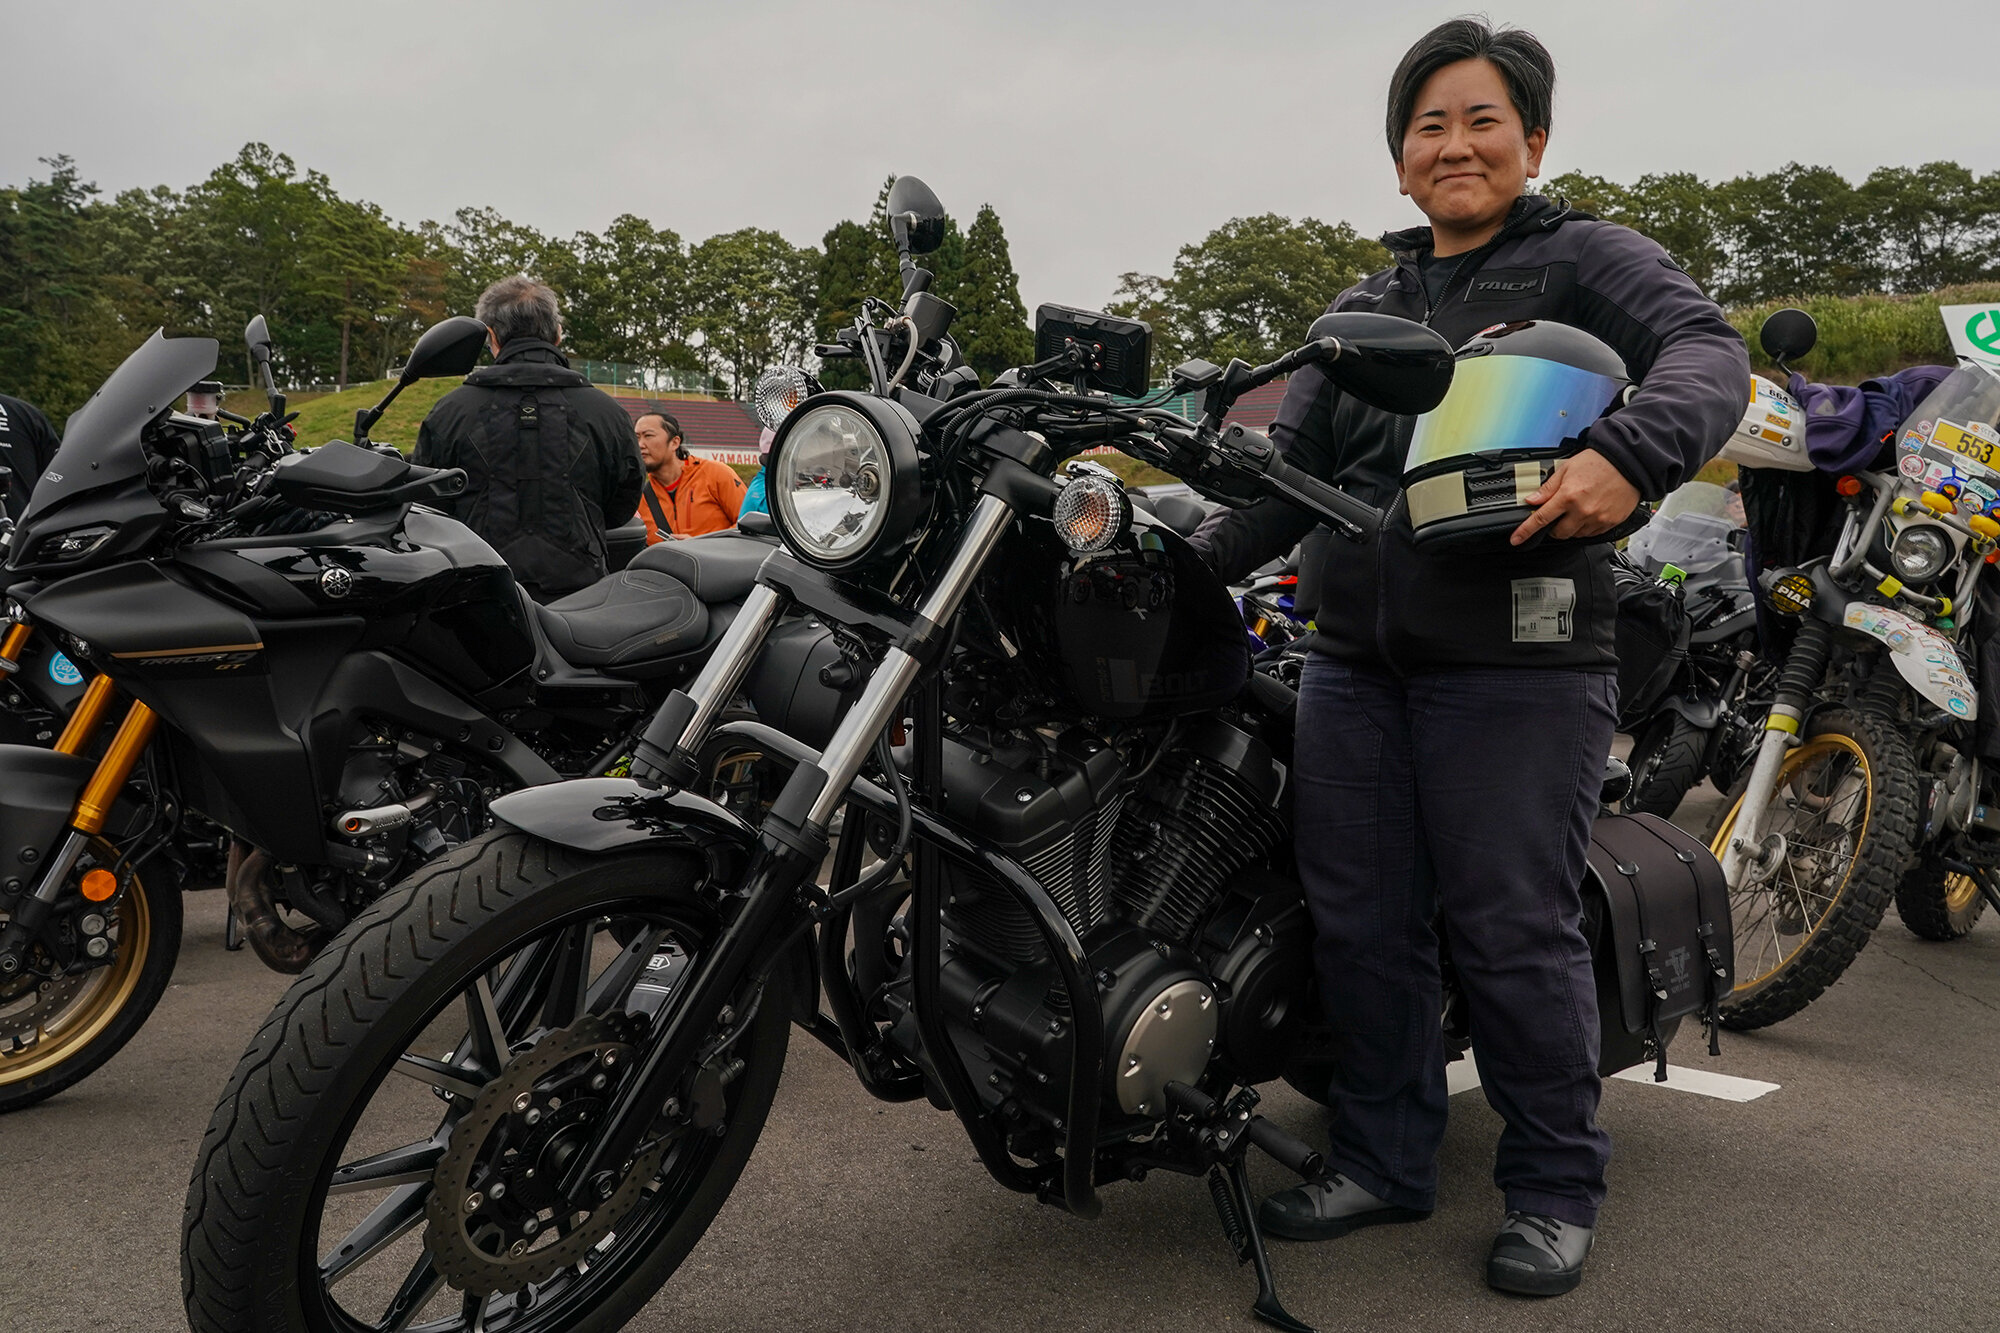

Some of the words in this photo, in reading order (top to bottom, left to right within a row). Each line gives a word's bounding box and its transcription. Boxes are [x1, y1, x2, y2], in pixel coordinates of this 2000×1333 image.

[1477, 279, 1539, 291] TAICHI
[1956, 432, 1994, 464] 553
[711, 452, 759, 465] YAMAHA
[1777, 585, 1811, 608] PIAA
[139, 653, 229, 666] TRACER
[214, 663, 246, 671] GT
